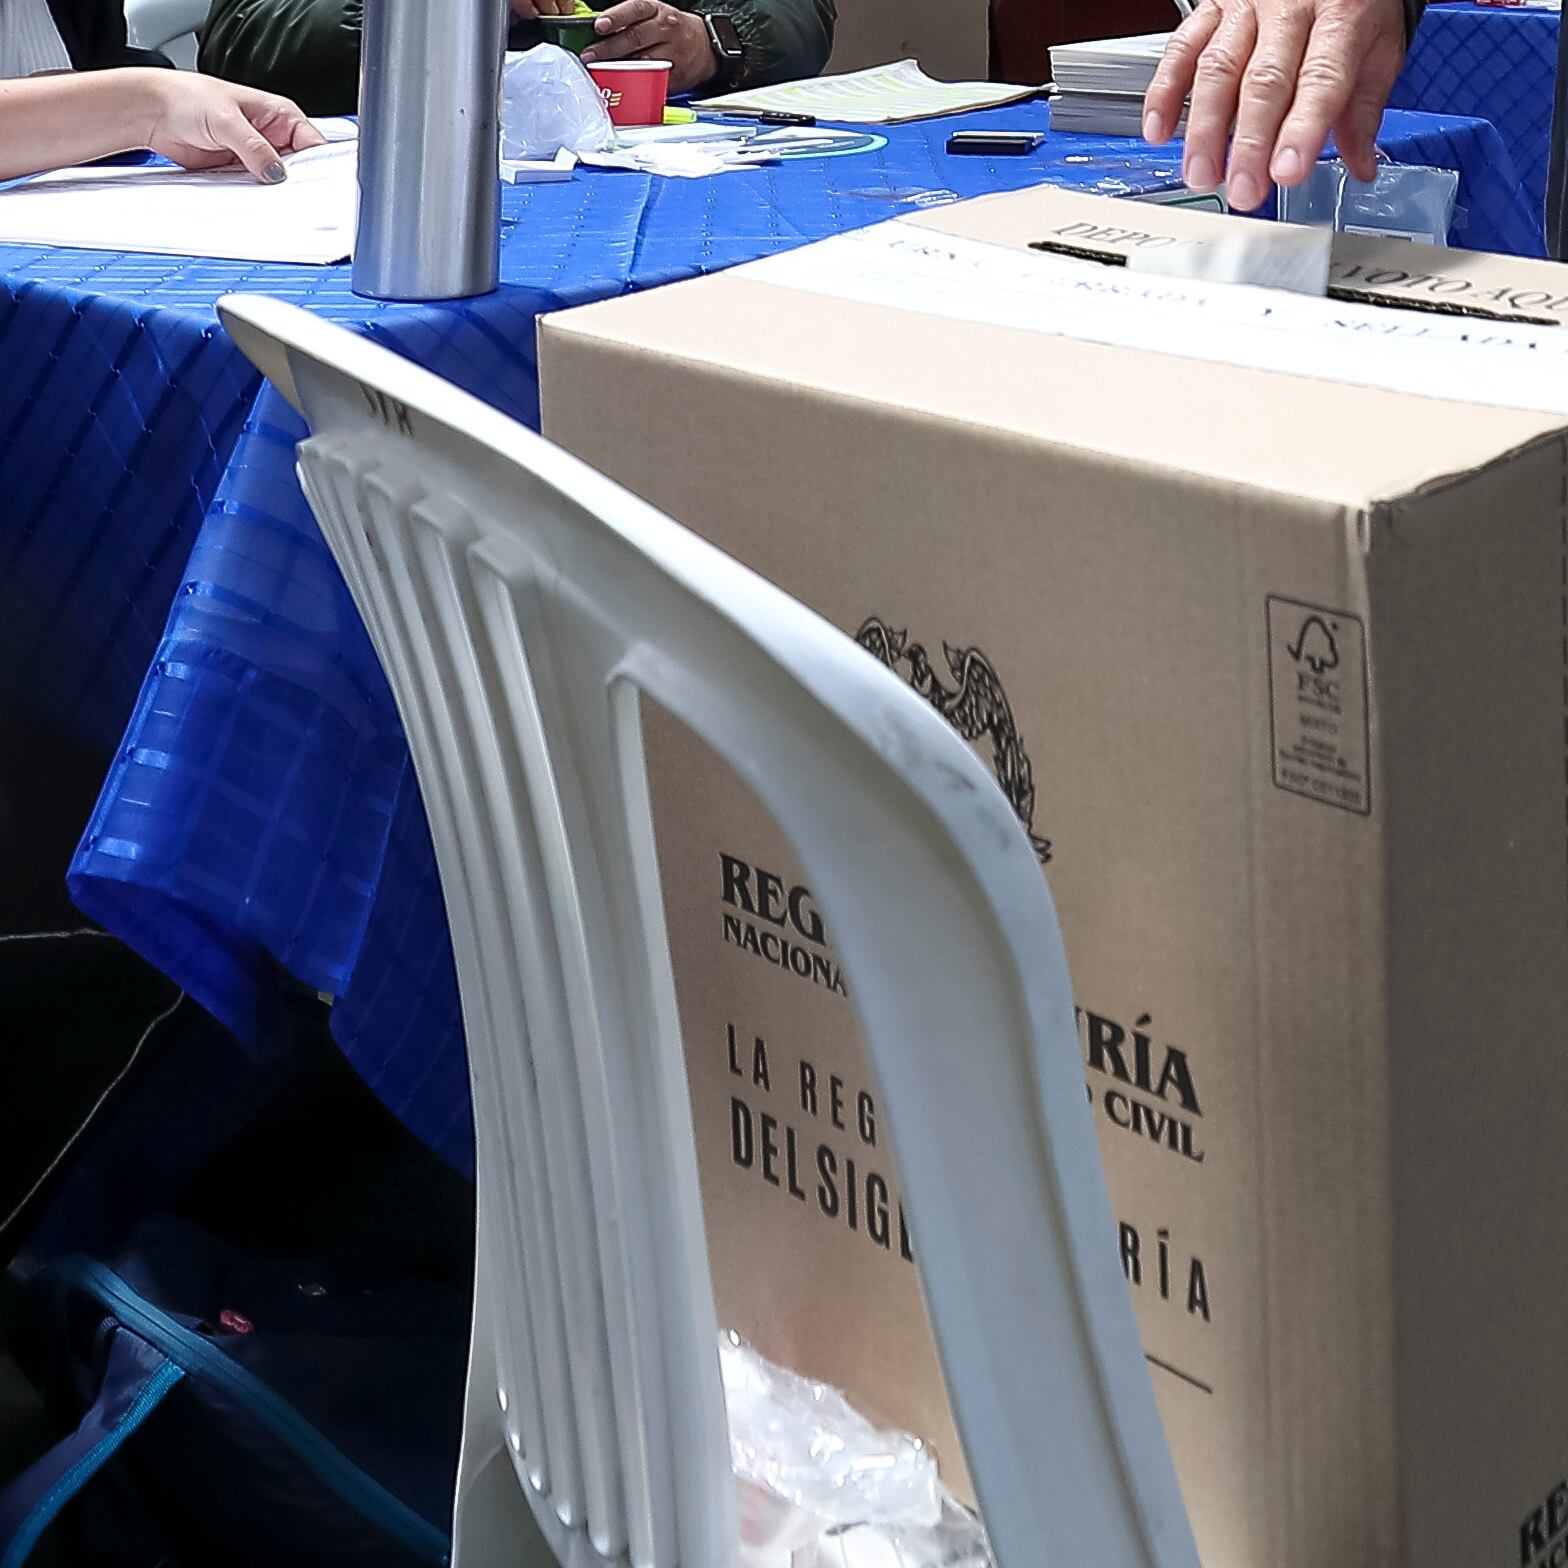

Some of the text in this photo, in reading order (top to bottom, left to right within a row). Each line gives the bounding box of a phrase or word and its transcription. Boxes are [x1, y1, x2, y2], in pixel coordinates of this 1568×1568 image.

[1054, 221, 1203, 249] DEPO
[727, 1023, 771, 1093] LA
[1075, 1007, 1204, 1118] RÍA
[1104, 1091, 1205, 1163] CIVIL
